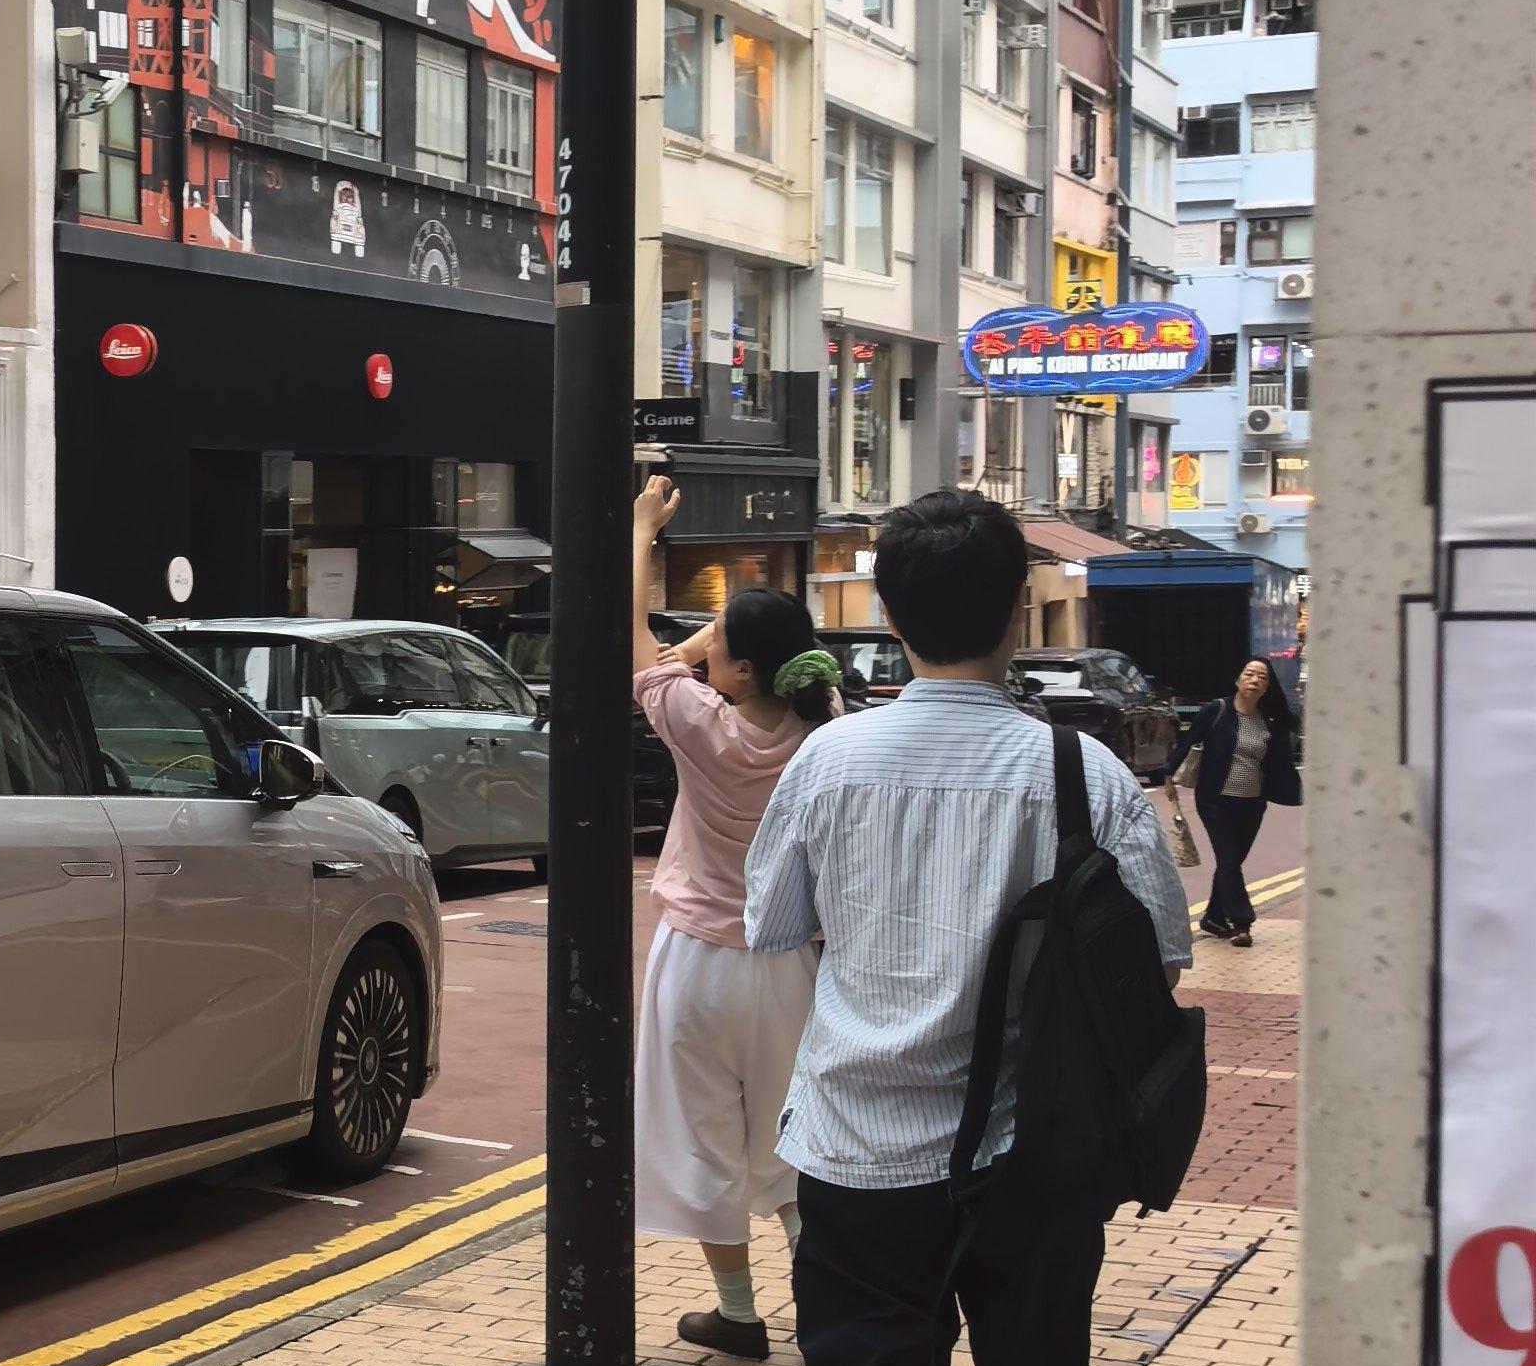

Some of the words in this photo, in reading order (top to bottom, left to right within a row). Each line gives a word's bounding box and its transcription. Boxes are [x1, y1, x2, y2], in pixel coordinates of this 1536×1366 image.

[558, 137, 572, 269] 47044
[1007, 356, 1044, 375] PING
[1046, 355, 1088, 373] KOON
[1091, 351, 1189, 371] RESTAURANT
[643, 413, 696, 426] Game
